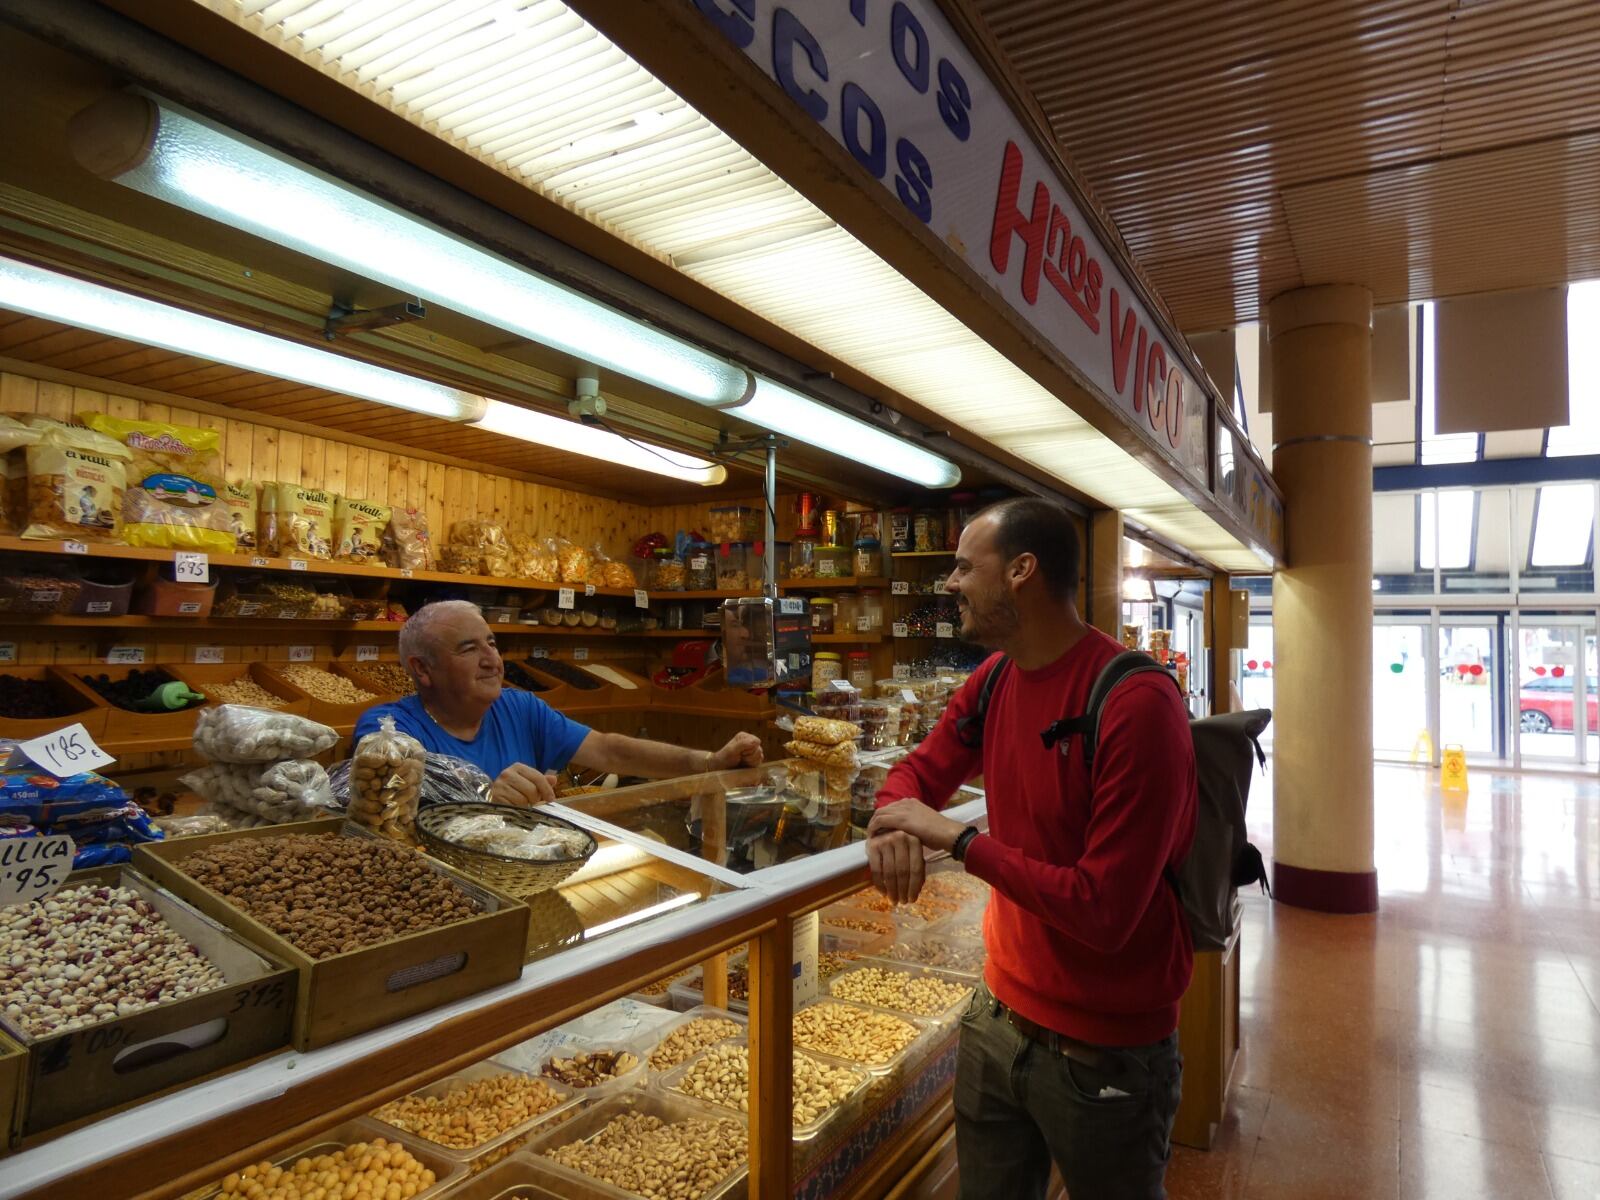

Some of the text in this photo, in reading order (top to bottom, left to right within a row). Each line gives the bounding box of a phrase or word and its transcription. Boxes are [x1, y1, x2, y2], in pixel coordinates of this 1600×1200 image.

[850, 0, 972, 142] OS
[990, 140, 1184, 449] Hnos VICO
[45, 732, 86, 768] 1'85
